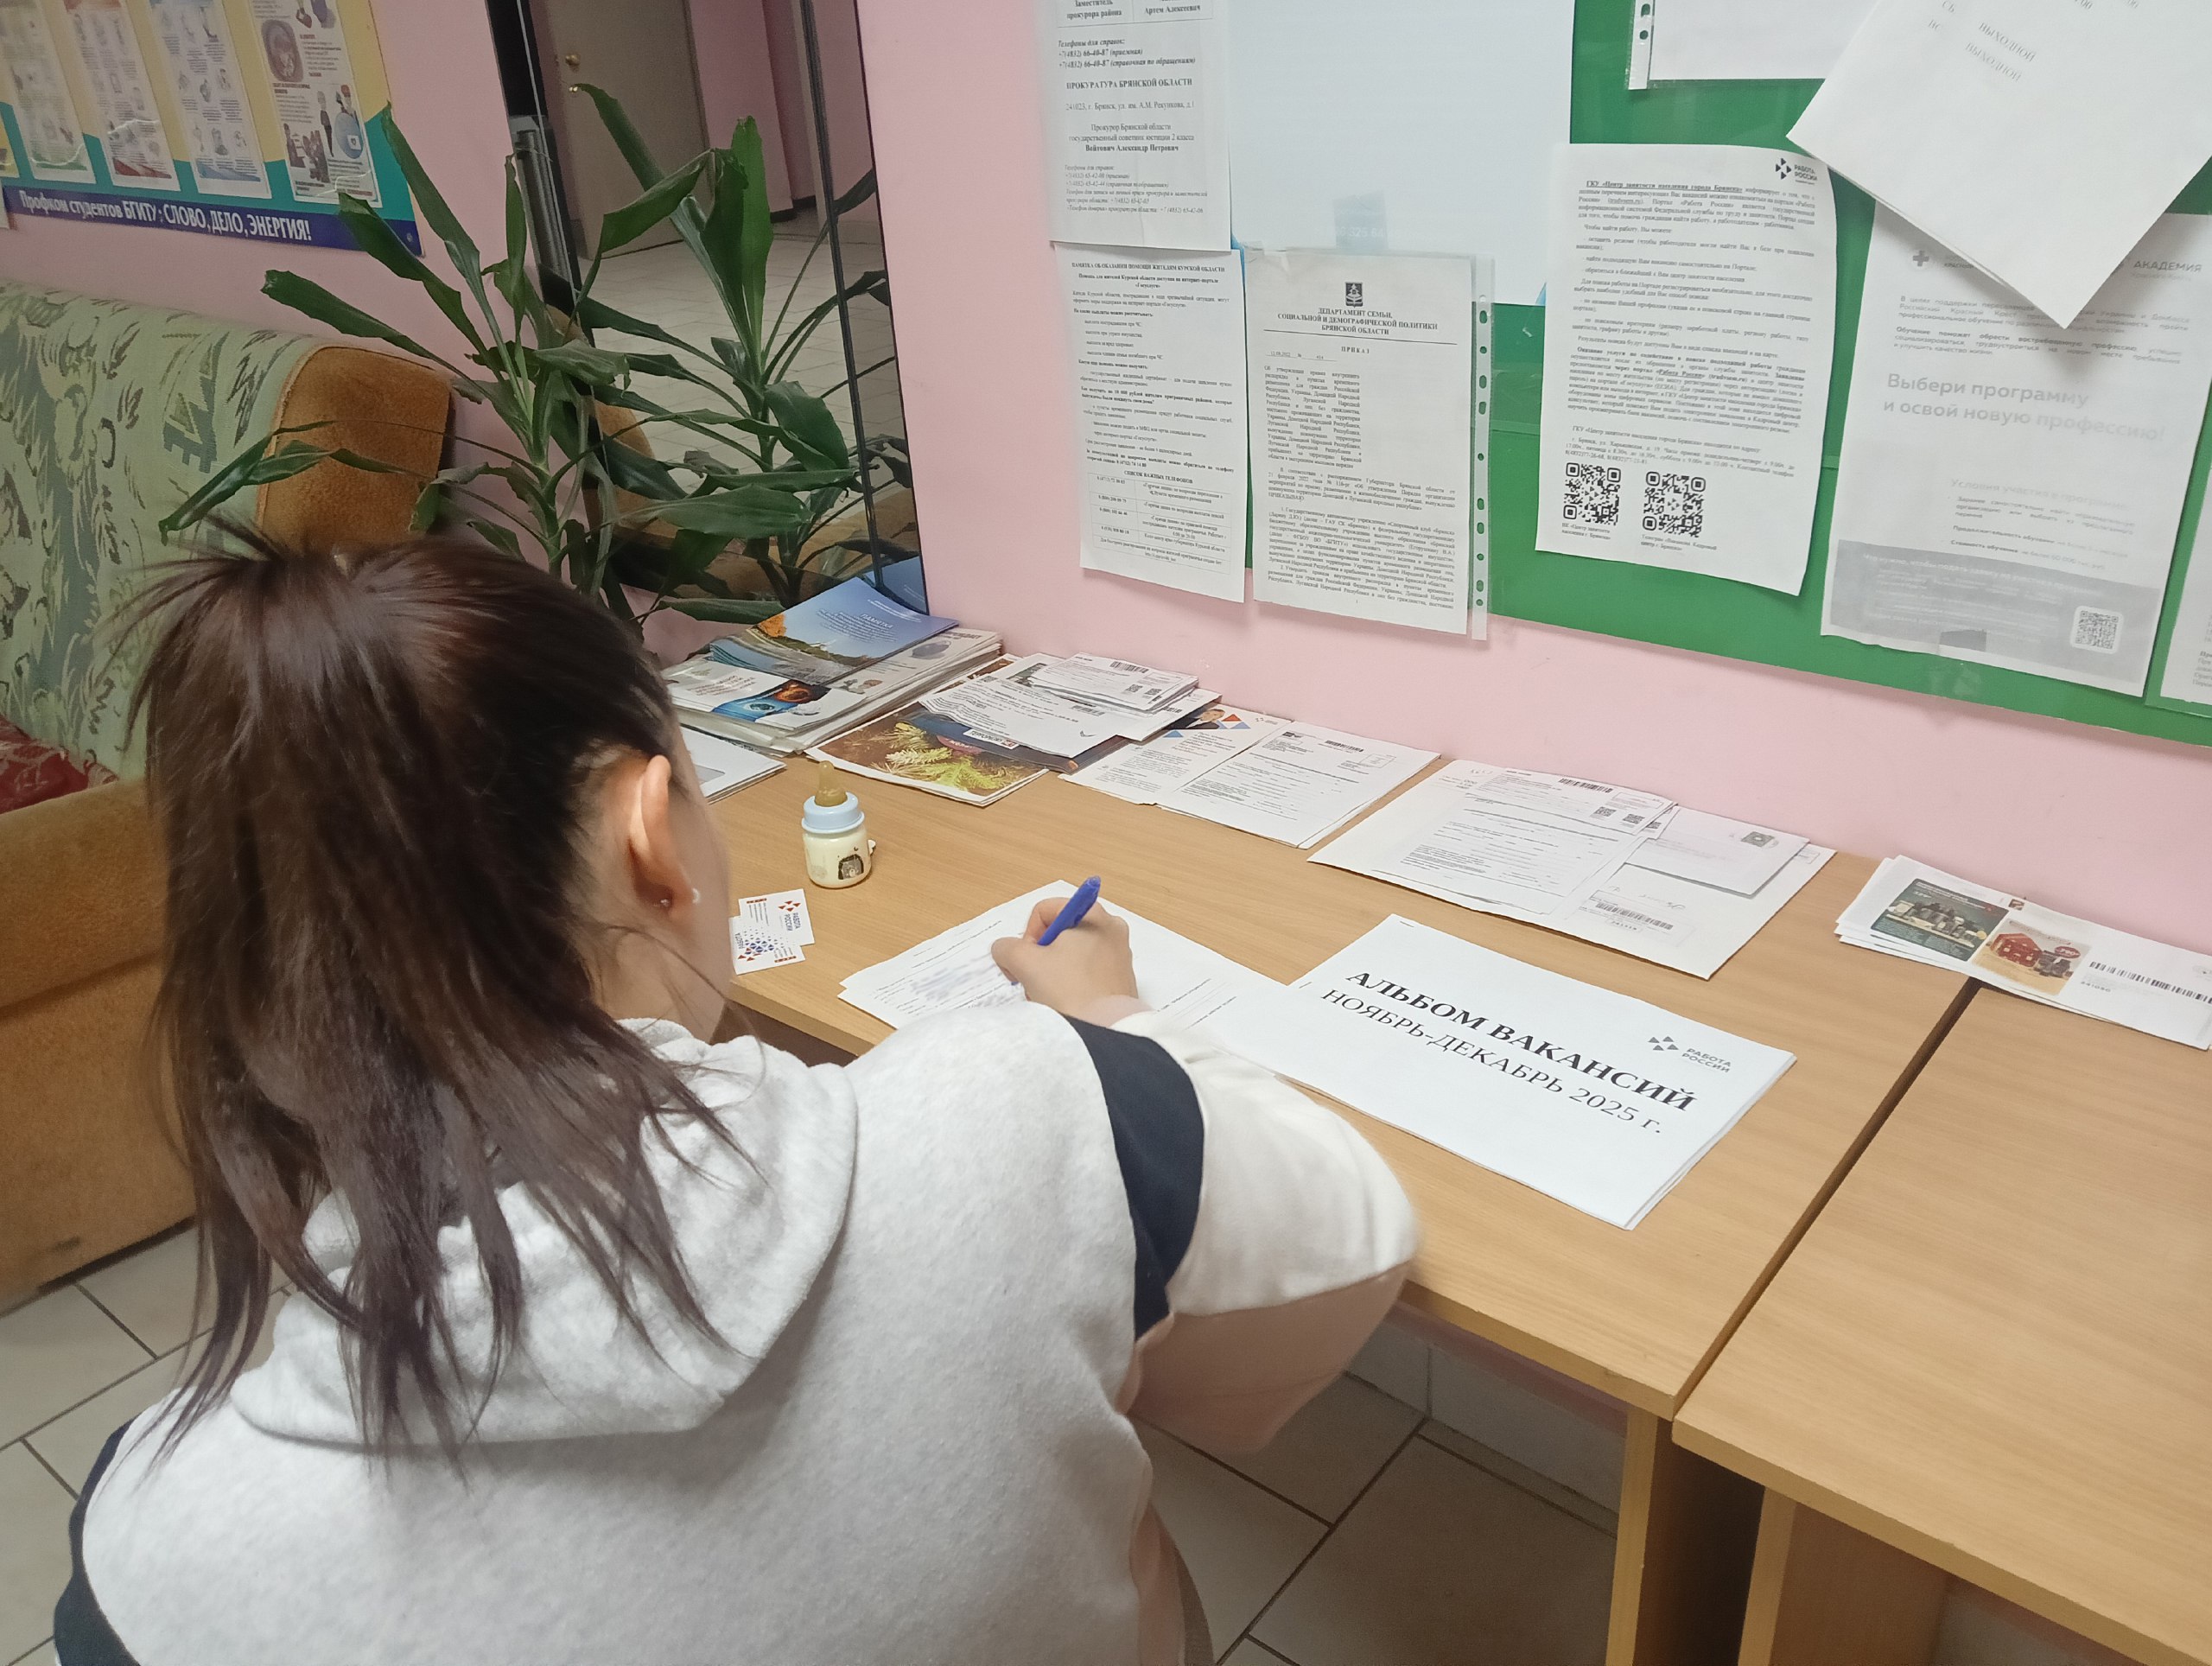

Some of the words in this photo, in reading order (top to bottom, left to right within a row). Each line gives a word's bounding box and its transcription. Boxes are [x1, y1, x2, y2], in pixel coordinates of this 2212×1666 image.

[1067, 11, 1099, 20] прокурора
[1101, 10, 1122, 18] района
[1978, 22, 2035, 62] ВЫХОДНОЙ
[1965, 42, 2022, 81] ВЫХОДНОЙ
[1119, 79, 1157, 87] БРЯНСКОЙ
[1159, 78, 1192, 86] ОБЛАСТИ
[18, 190, 68, 215] Профком
[70, 200, 124, 221] студентов
[249, 213, 312, 241] ЭНЕРГИЯ!
[2133, 261, 2202, 272] АКАДЕМИЯ
[1277, 314, 1321, 322] СОЦИАЛЬНОЙ
[1328, 316, 1397, 327] ДЕМОГРАФИЧЕСКОЙ
[1398, 321, 1438, 330] ПОЛИТИКИ
[1318, 308, 1365, 317] ДЕПАРТАМЕНТ
[1886, 372, 1967, 397] Выбери
[1971, 384, 2089, 410] программу
[1884, 400, 1895, 412] и
[1900, 400, 1959, 418] освой
[1963, 408, 2031, 427] новую
[2036, 413, 2165, 442] профессию!
[860, 614, 894, 629] ПАМЯТКА
[1345, 972, 1489, 1031] АЛЬБОМ
[1487, 1023, 1698, 1111] ВАКАНСИЙ
[1320, 989, 1564, 1094] НОЯБРЬ-ДЕКАБРЬ
[1568, 1086, 1639, 1122] 2025
[1641, 1117, 1661, 1133] г.
[1681, 1052, 1730, 1072] РОССИИ
[1686, 1048, 1731, 1066] РАБОТА
